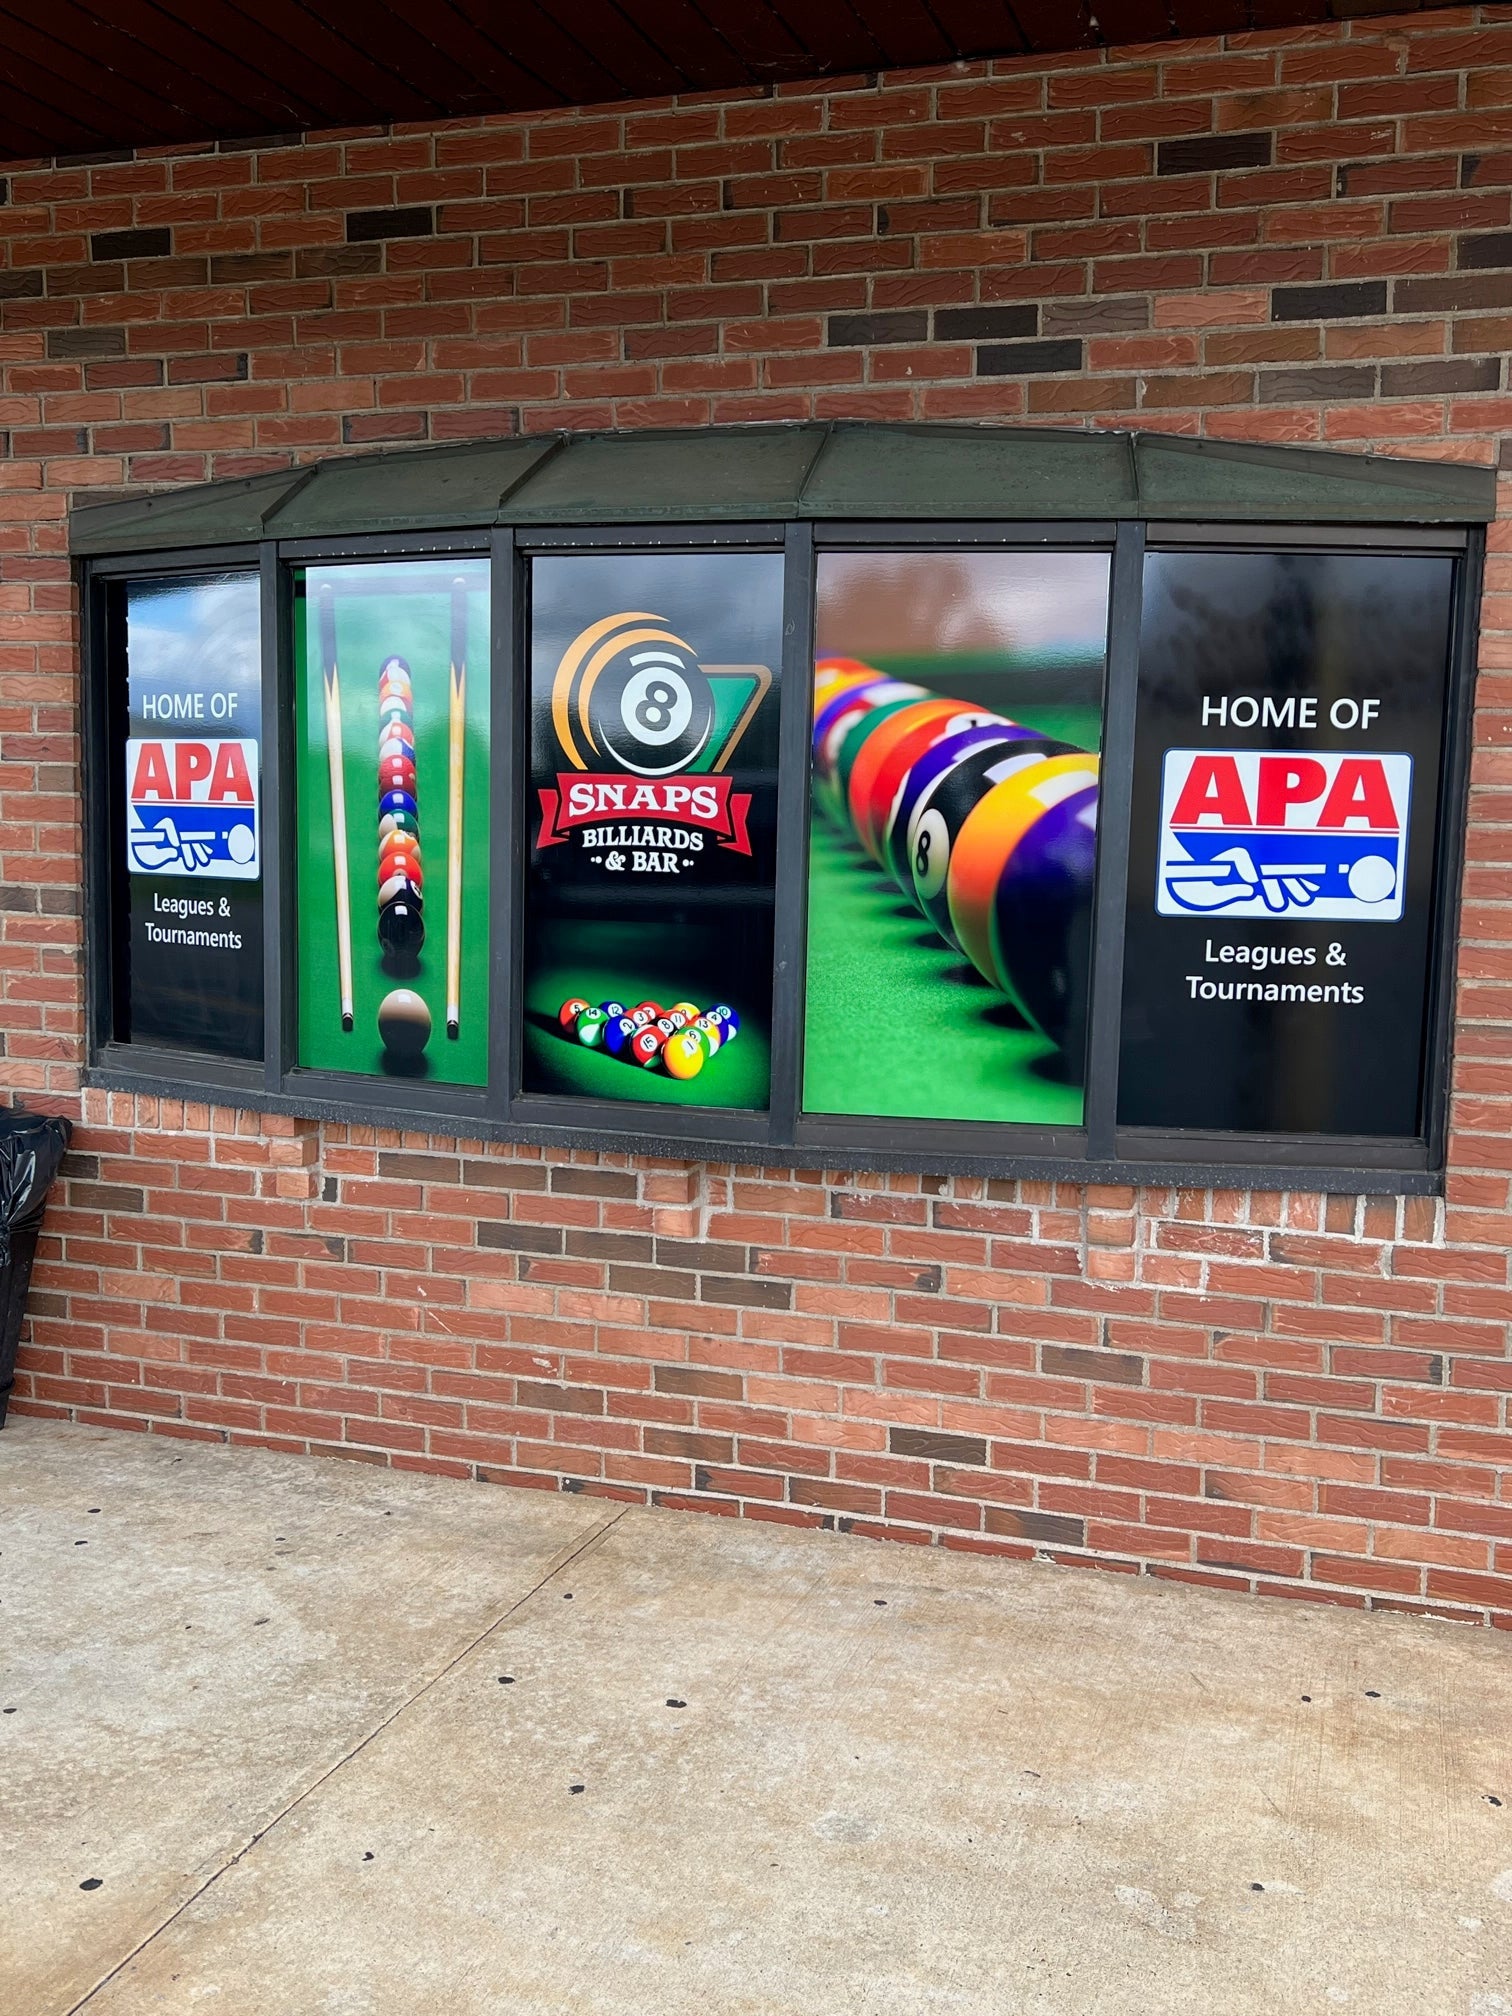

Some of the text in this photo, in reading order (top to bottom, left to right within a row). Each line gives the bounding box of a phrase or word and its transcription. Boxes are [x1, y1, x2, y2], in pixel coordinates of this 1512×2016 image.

[143, 692, 238, 719] HOME OF
[635, 680, 678, 731] 8
[1201, 695, 1380, 729] HOME OF
[131, 743, 255, 801] APA
[568, 783, 719, 819] SNAPS
[1169, 755, 1400, 829] APA
[582, 825, 704, 851] BILLIARDS
[605, 850, 680, 873] & BAR
[916, 830, 931, 877] 8
[154, 892, 231, 919] Leagues &
[145, 922, 242, 949] Tournaments
[1204, 939, 1347, 970] Leagues &
[1185, 975, 1364, 1004] Tournaments
[661, 1020, 671, 1029] 8
[698, 1020, 709, 1028] 13
[719, 1007, 728, 1016] 10
[642, 1036, 654, 1049] 15
